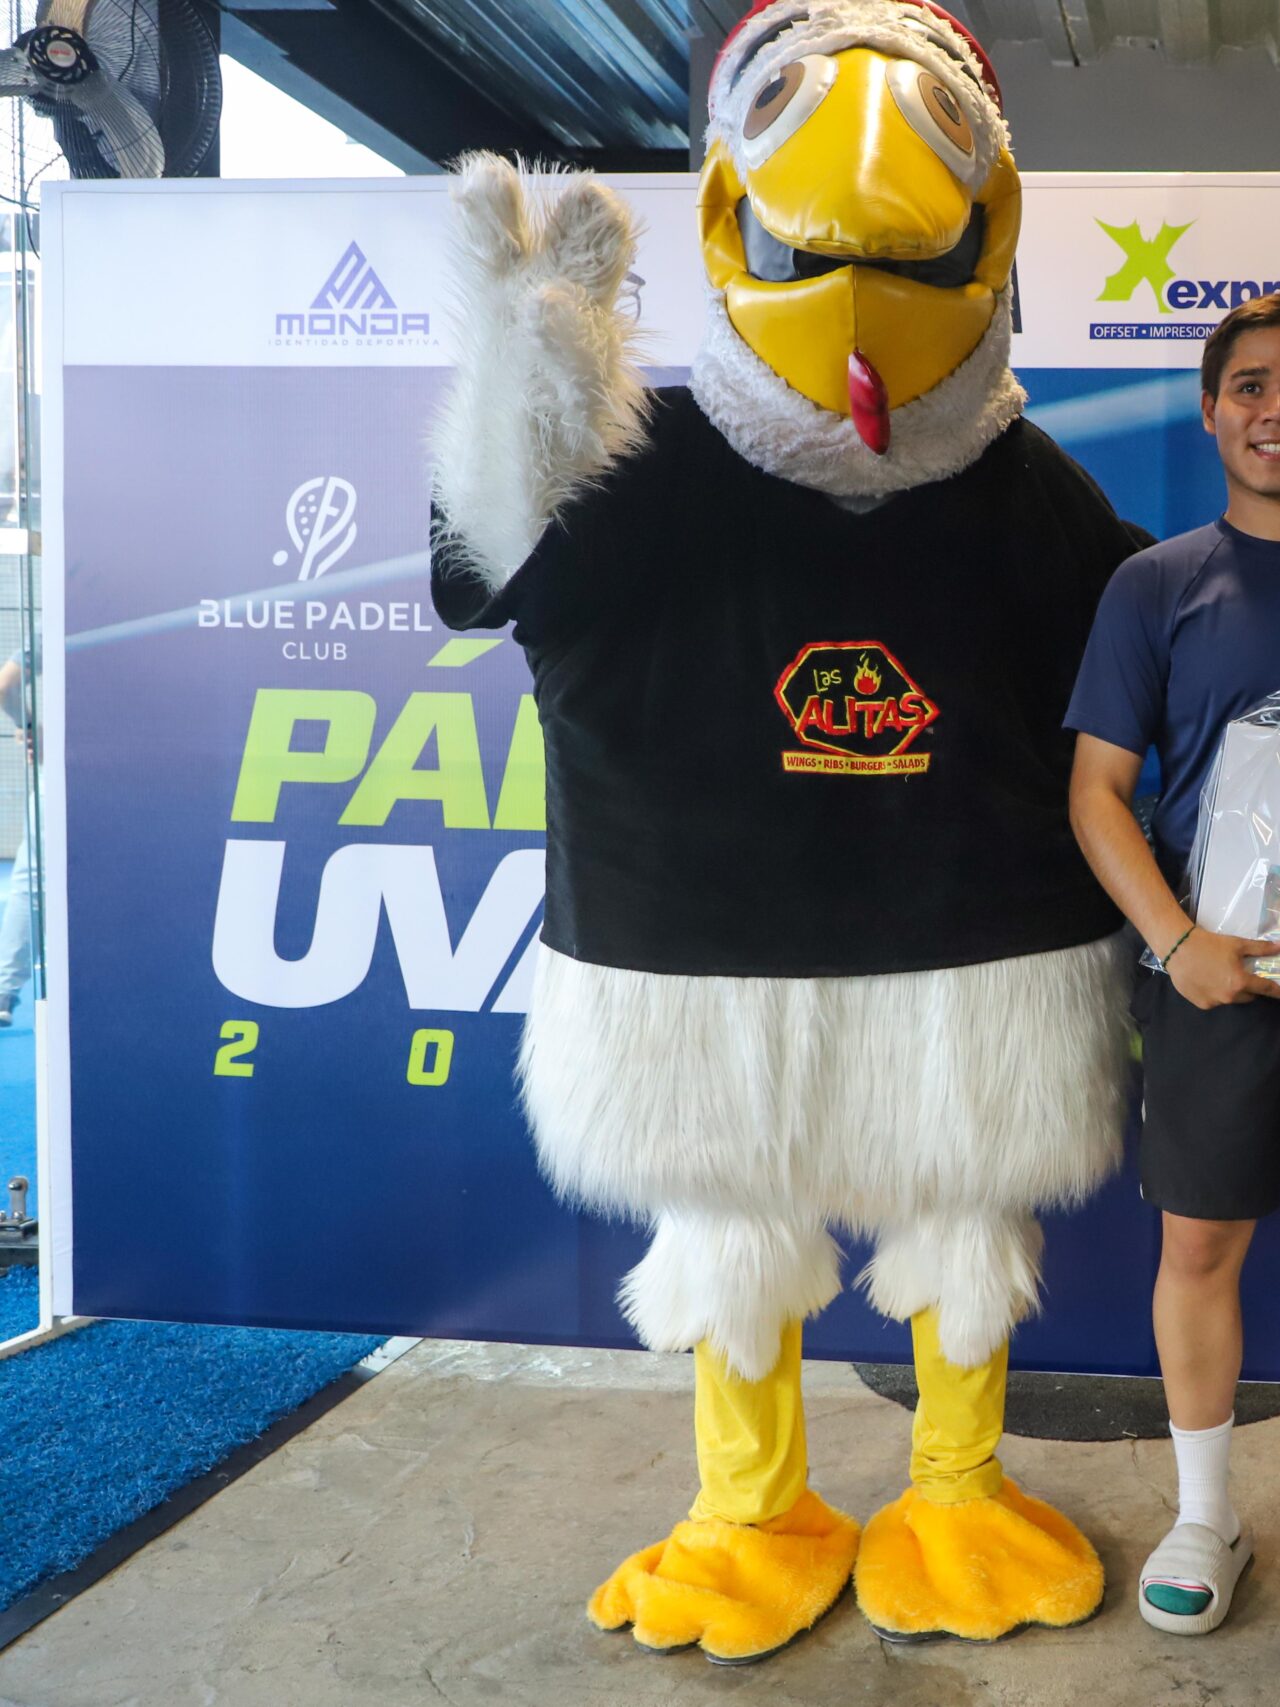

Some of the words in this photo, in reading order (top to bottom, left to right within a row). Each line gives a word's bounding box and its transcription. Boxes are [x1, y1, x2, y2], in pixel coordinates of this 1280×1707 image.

[276, 314, 430, 335] MONDA
[1094, 326, 1138, 338] OFFSET
[1150, 326, 1215, 338] IMPRESION
[267, 338, 350, 347] IDENTIDAD
[355, 338, 441, 347] DEPORTIVA
[198, 599, 295, 629] BLUE
[306, 601, 433, 632] PADEL
[282, 642, 347, 660] CLUB
[796, 692, 926, 738] ALITAS
[230, 638, 547, 830] PÁ
[787, 757, 816, 767] WINGS
[824, 760, 844, 769] RIBS
[893, 759, 926, 769] SALADS
[213, 1020, 259, 1077] 2
[406, 1029, 455, 1086] 0
